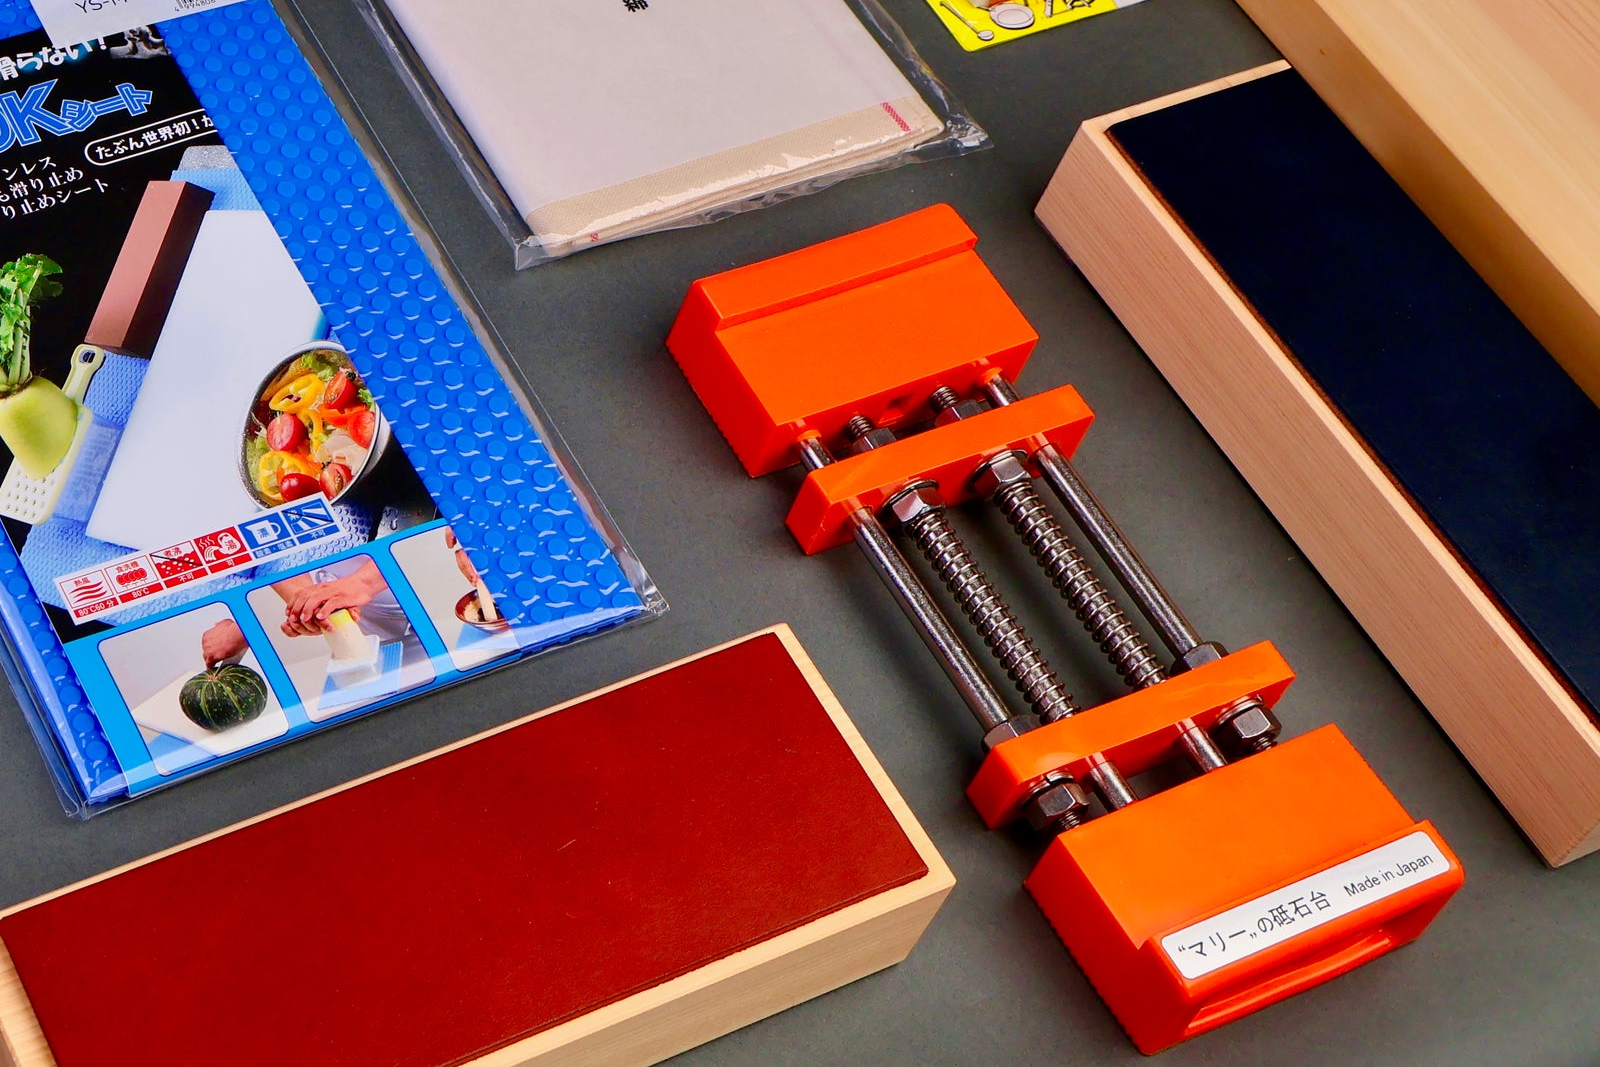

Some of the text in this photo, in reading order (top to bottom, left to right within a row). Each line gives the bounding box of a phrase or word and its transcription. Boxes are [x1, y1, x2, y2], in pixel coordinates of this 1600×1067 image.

[179, 572, 195, 583] 不可
[1343, 852, 1434, 897] Made in Japan
